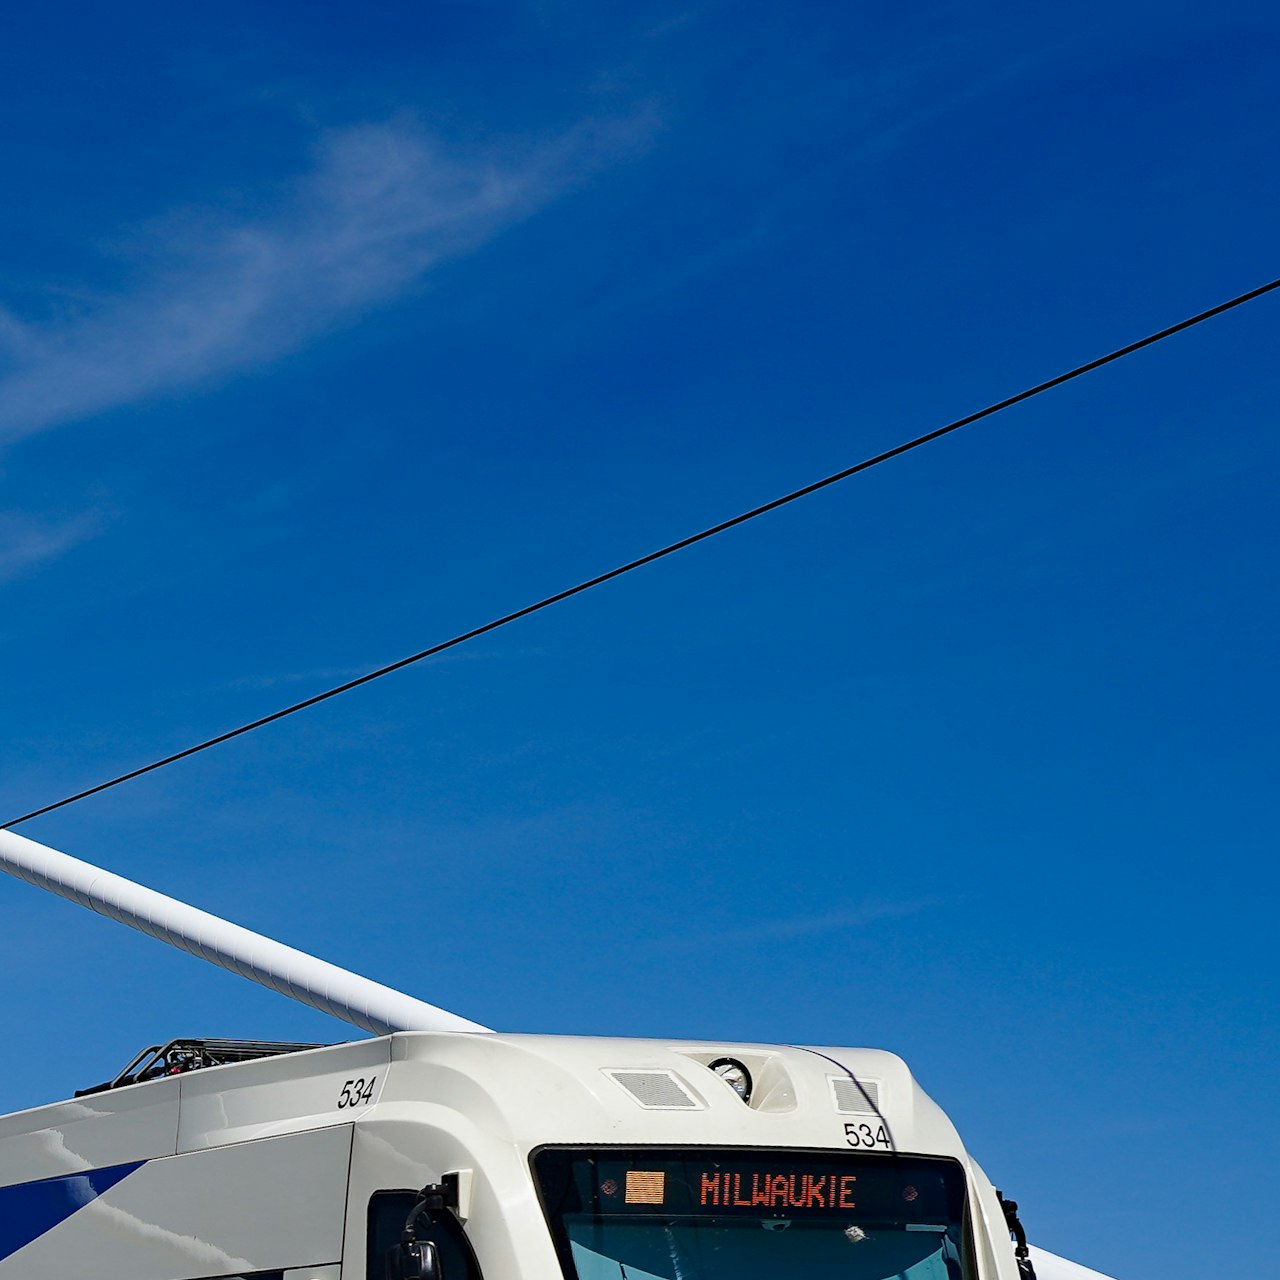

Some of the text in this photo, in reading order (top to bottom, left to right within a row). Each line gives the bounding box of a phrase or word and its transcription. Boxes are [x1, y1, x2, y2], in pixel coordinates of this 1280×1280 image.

[337, 1076, 377, 1109] 534
[843, 1122, 891, 1148] 534
[700, 1171, 857, 1209] MILWAUKIE
